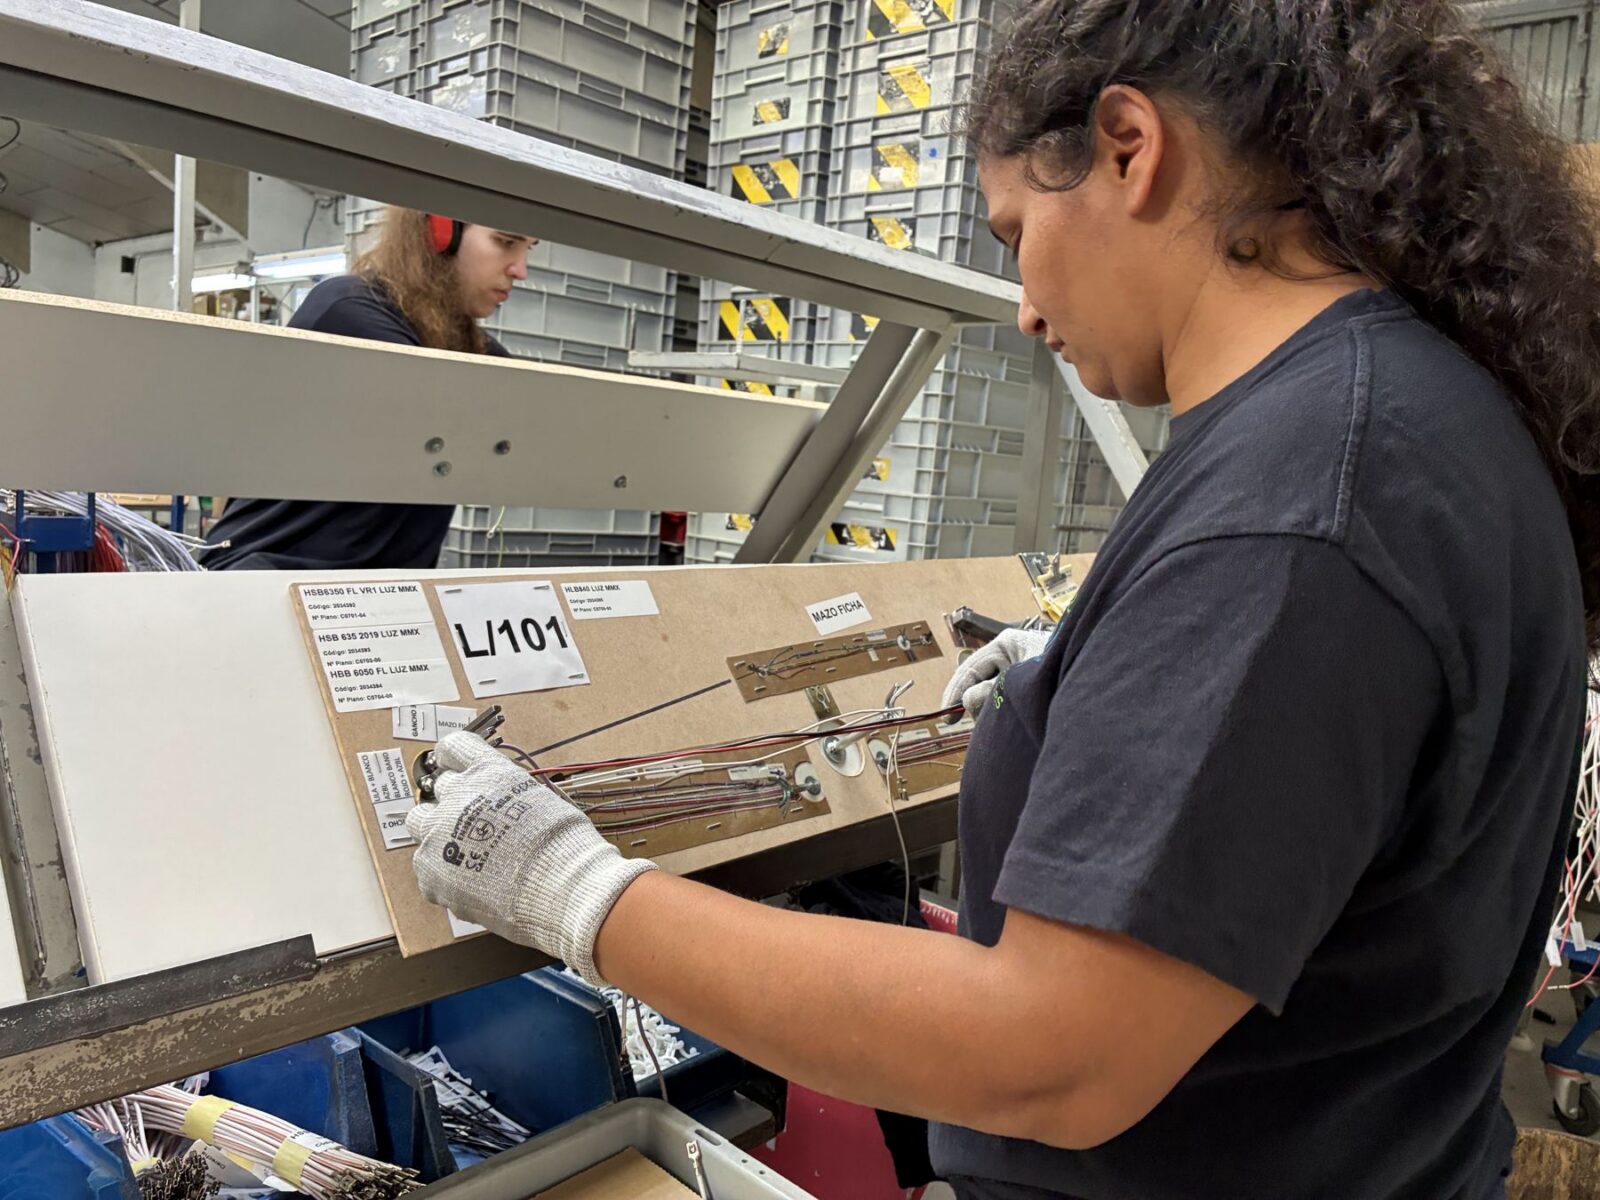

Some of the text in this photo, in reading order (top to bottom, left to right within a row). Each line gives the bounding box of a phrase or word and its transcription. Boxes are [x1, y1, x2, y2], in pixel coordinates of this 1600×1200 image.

[303, 585, 418, 597] HSB6350 FL VR1 LUZ MMX
[811, 599, 864, 623] MAZO FICHA
[318, 628, 420, 642] HSB 635 2019 LUZ MMX
[454, 615, 568, 658] L/101
[330, 664, 430, 678] HBB 6050 FL LUZ MMX
[410, 709, 418, 737] GANCHO
[438, 720, 457, 728] MAZO
[361, 755, 375, 782] BLANCO
[383, 752, 401, 798] BLANCO BAND
[371, 788, 381, 802] LILA
[401, 779, 410, 797] ROJO
